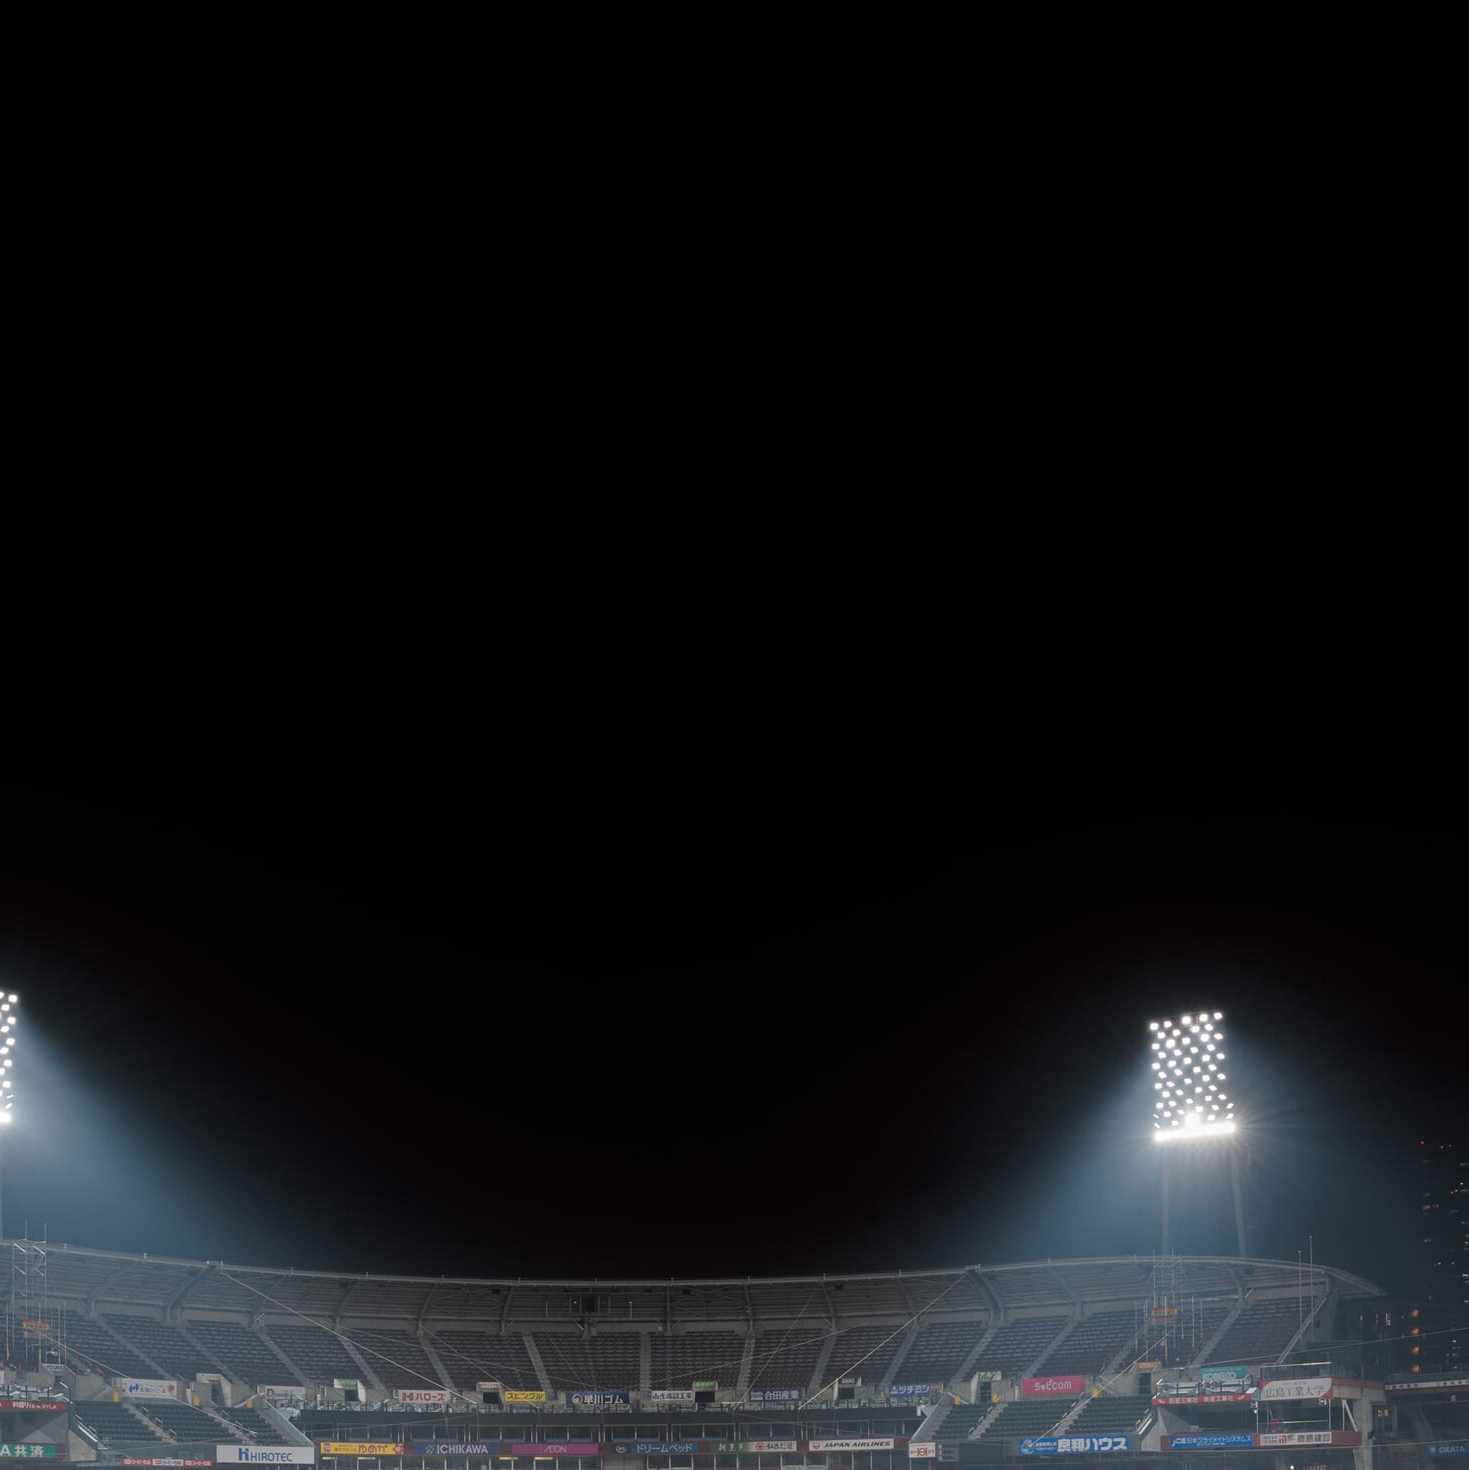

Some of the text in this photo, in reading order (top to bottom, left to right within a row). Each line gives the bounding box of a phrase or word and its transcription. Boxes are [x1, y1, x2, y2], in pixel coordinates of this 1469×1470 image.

[415, 1392, 445, 1401] ハローズ
[1266, 1386, 1324, 1399] 広島工業大学
[437, 1444, 489, 1454] ICHIKAWA
[1057, 1437, 1128, 1452] 良和ハウス
[250, 1453, 293, 1462] HIROTEC
